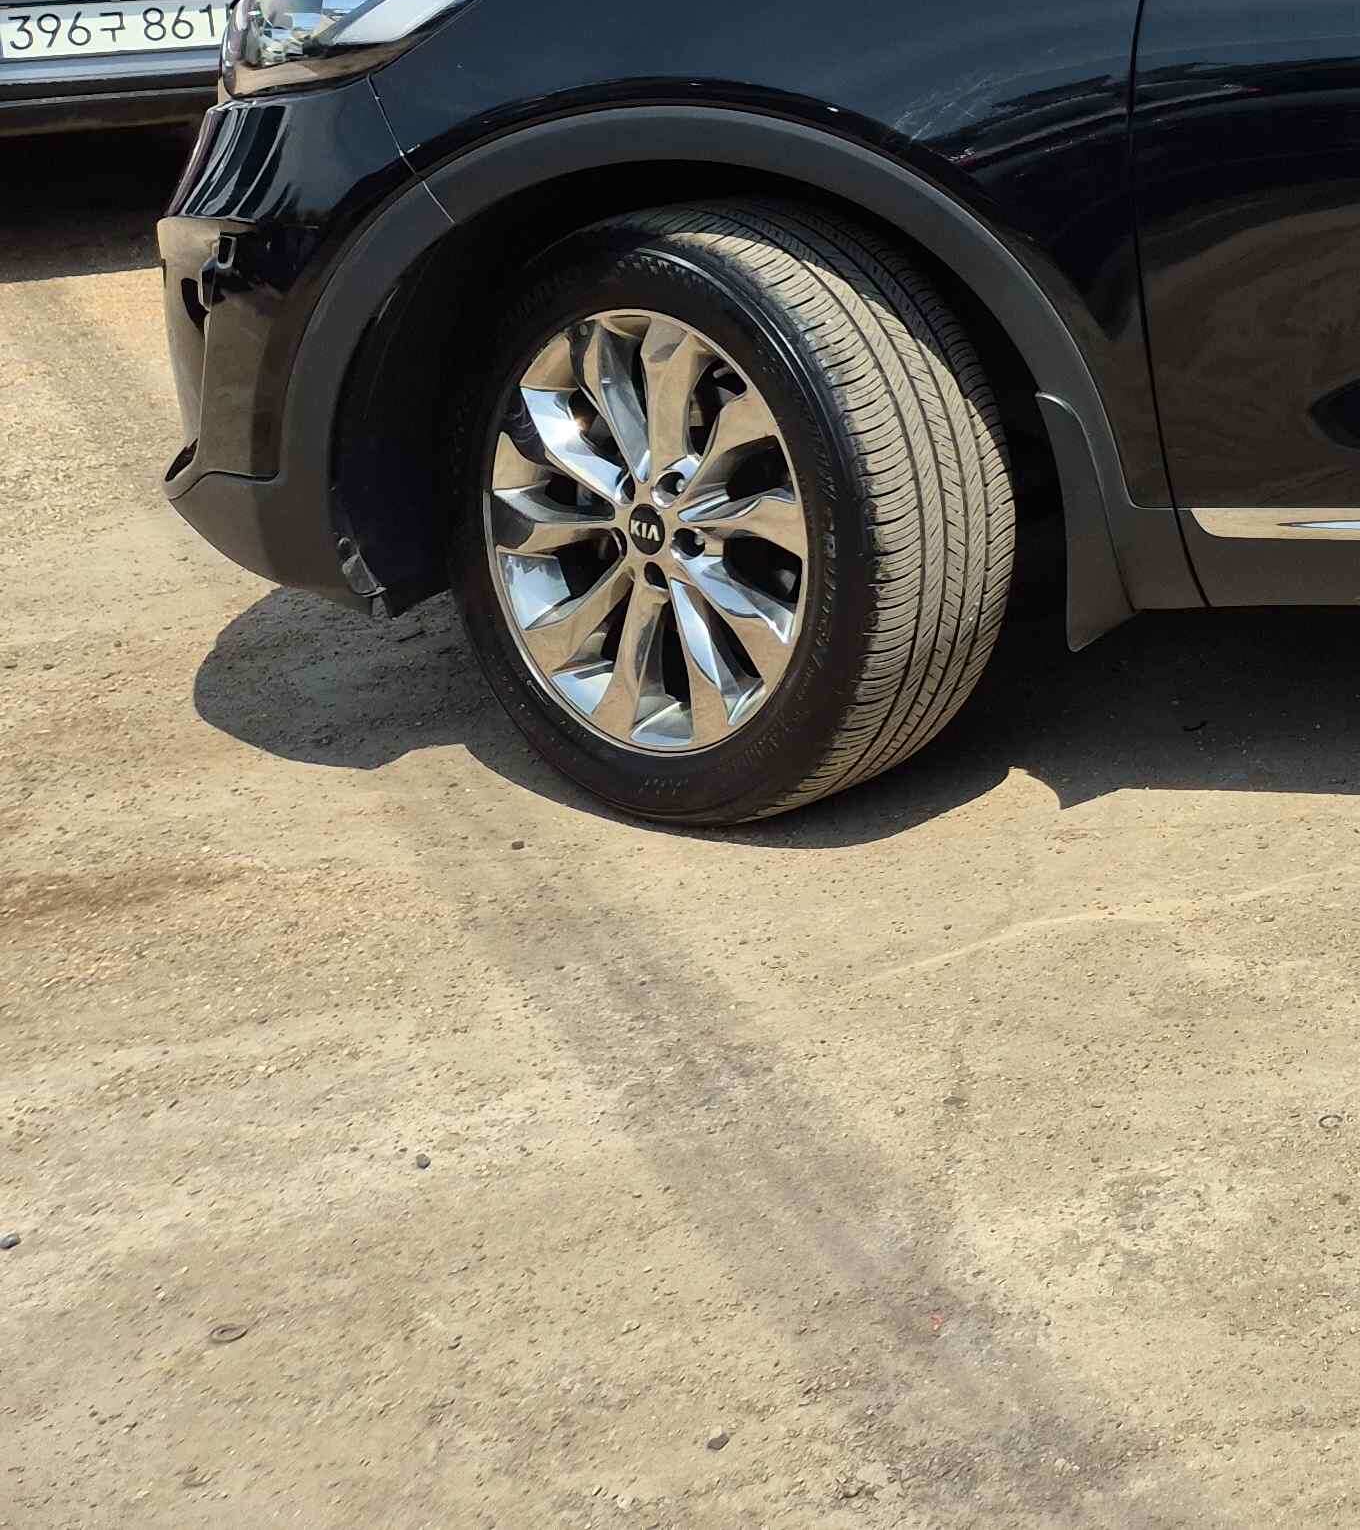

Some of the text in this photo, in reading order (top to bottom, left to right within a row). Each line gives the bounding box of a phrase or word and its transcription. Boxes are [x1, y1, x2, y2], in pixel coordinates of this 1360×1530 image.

[8, 3, 230, 51] 396구 861
[630, 519, 661, 542] KIA
